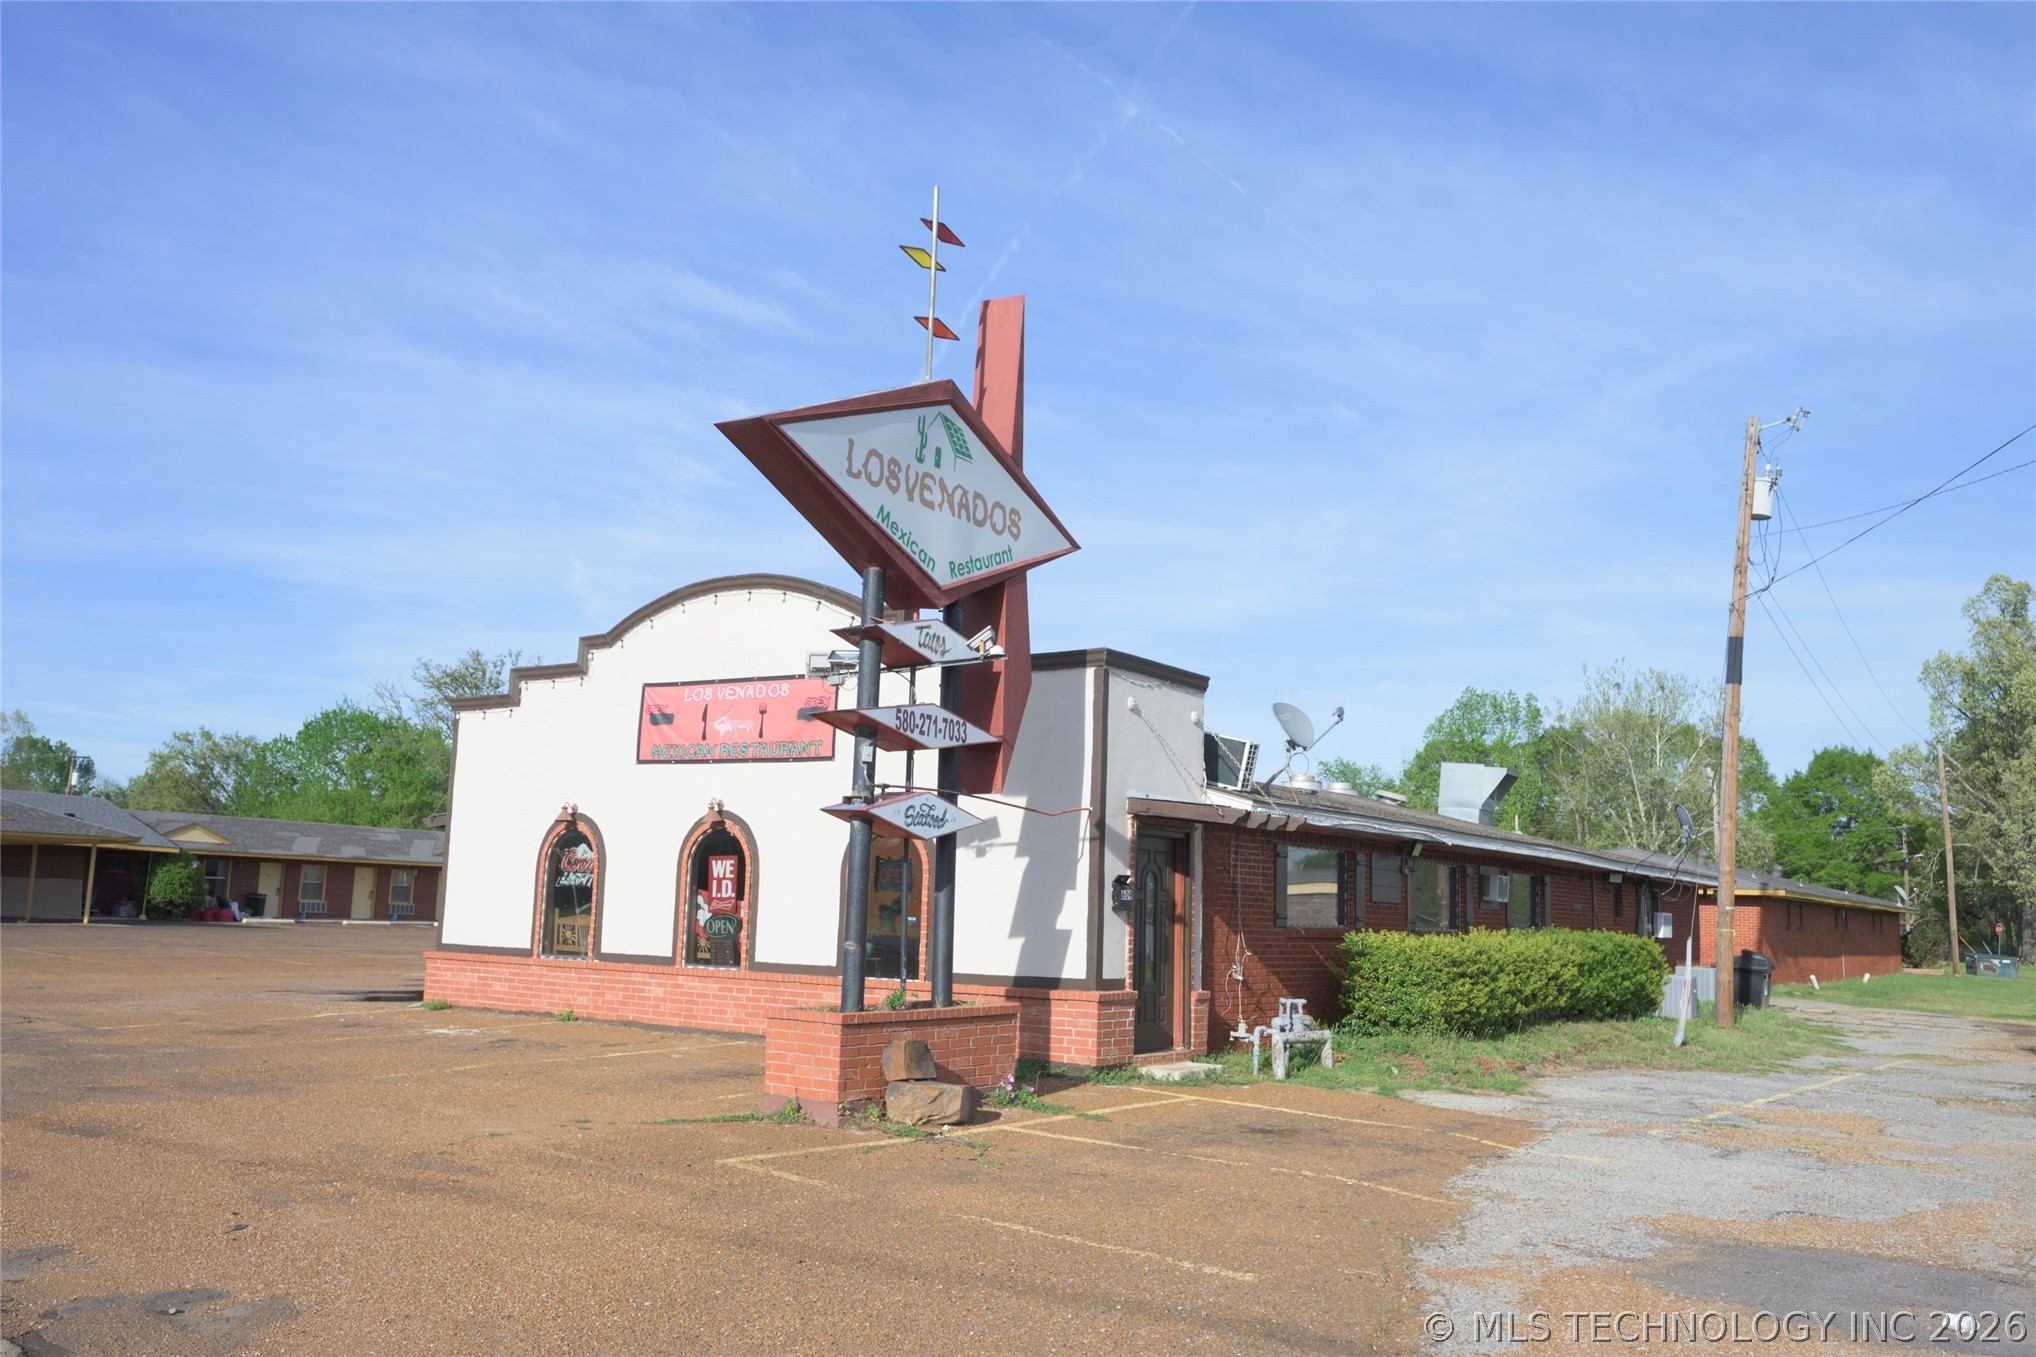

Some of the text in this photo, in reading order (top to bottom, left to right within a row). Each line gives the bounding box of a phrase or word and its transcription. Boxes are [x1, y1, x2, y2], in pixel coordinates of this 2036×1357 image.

[876, 504, 936, 573] Mexican
[949, 545, 1014, 579] Restaurant
[915, 624, 952, 658] Tacos
[684, 682, 790, 702] LOS VENADOS
[895, 707, 968, 744] 580-271-7033
[651, 740, 823, 759] MEXICAN RESTAURANT
[712, 860, 735, 878] WE
[712, 880, 735, 898] I.D.
[706, 919, 734, 934] OPEN
